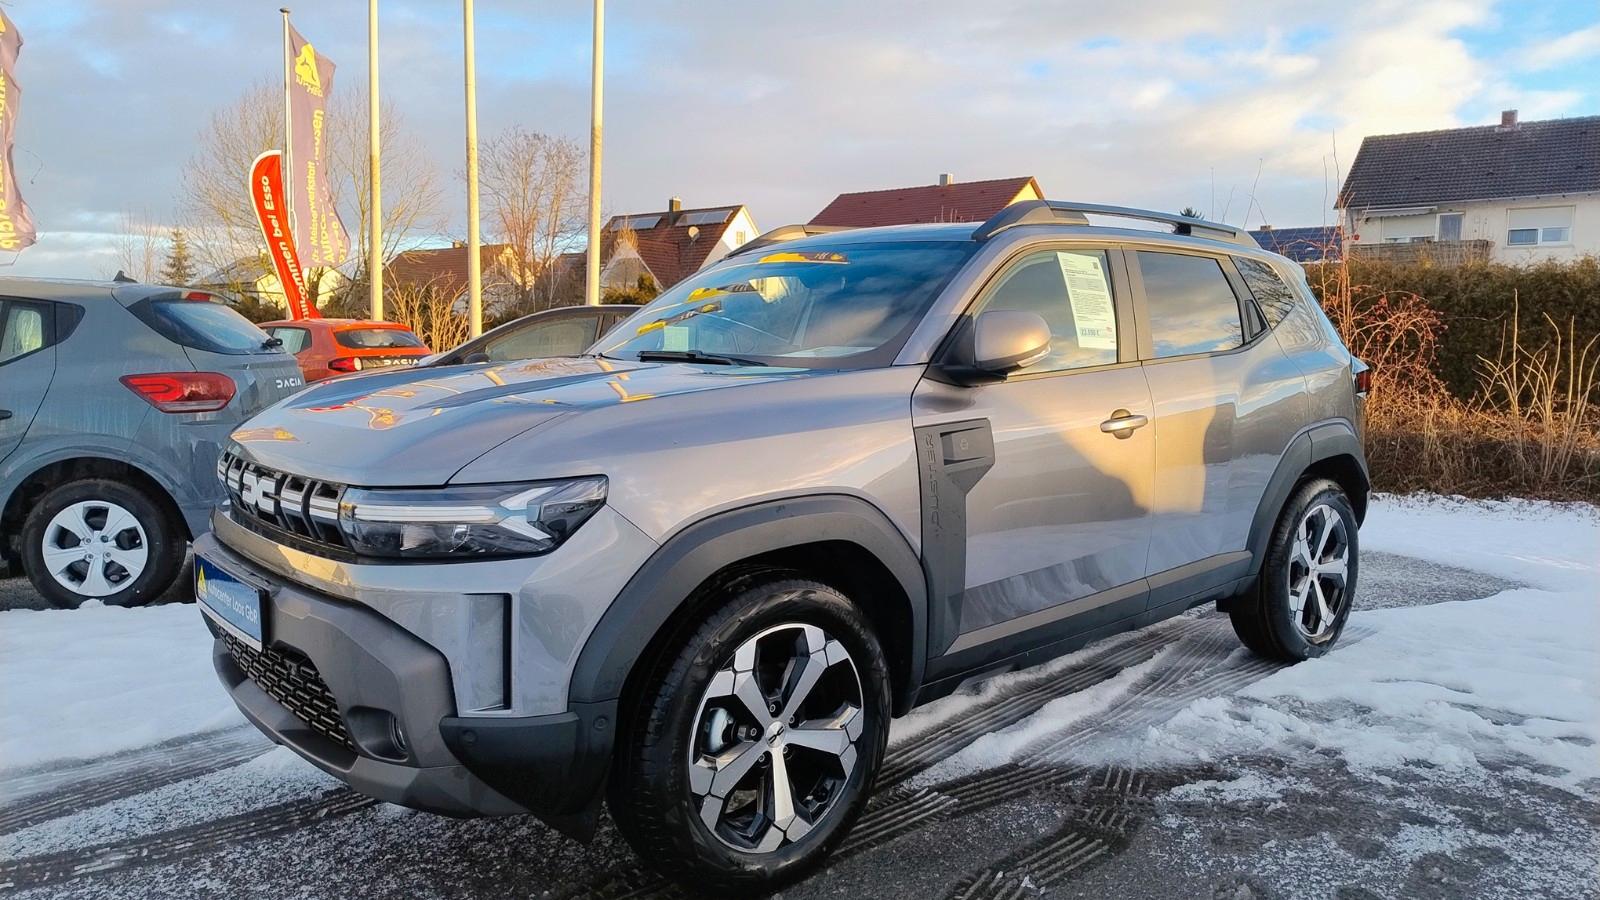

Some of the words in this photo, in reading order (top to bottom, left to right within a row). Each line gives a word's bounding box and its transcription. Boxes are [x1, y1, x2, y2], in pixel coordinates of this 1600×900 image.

[261, 175, 275, 211] Esso
[267, 215, 283, 237] bei
[383, 358, 420, 366] DACIA
[275, 377, 302, 389] DACIA
[925, 434, 943, 530] DUSTER
[232, 596, 245, 617] Loos
[245, 604, 258, 624] GbR
